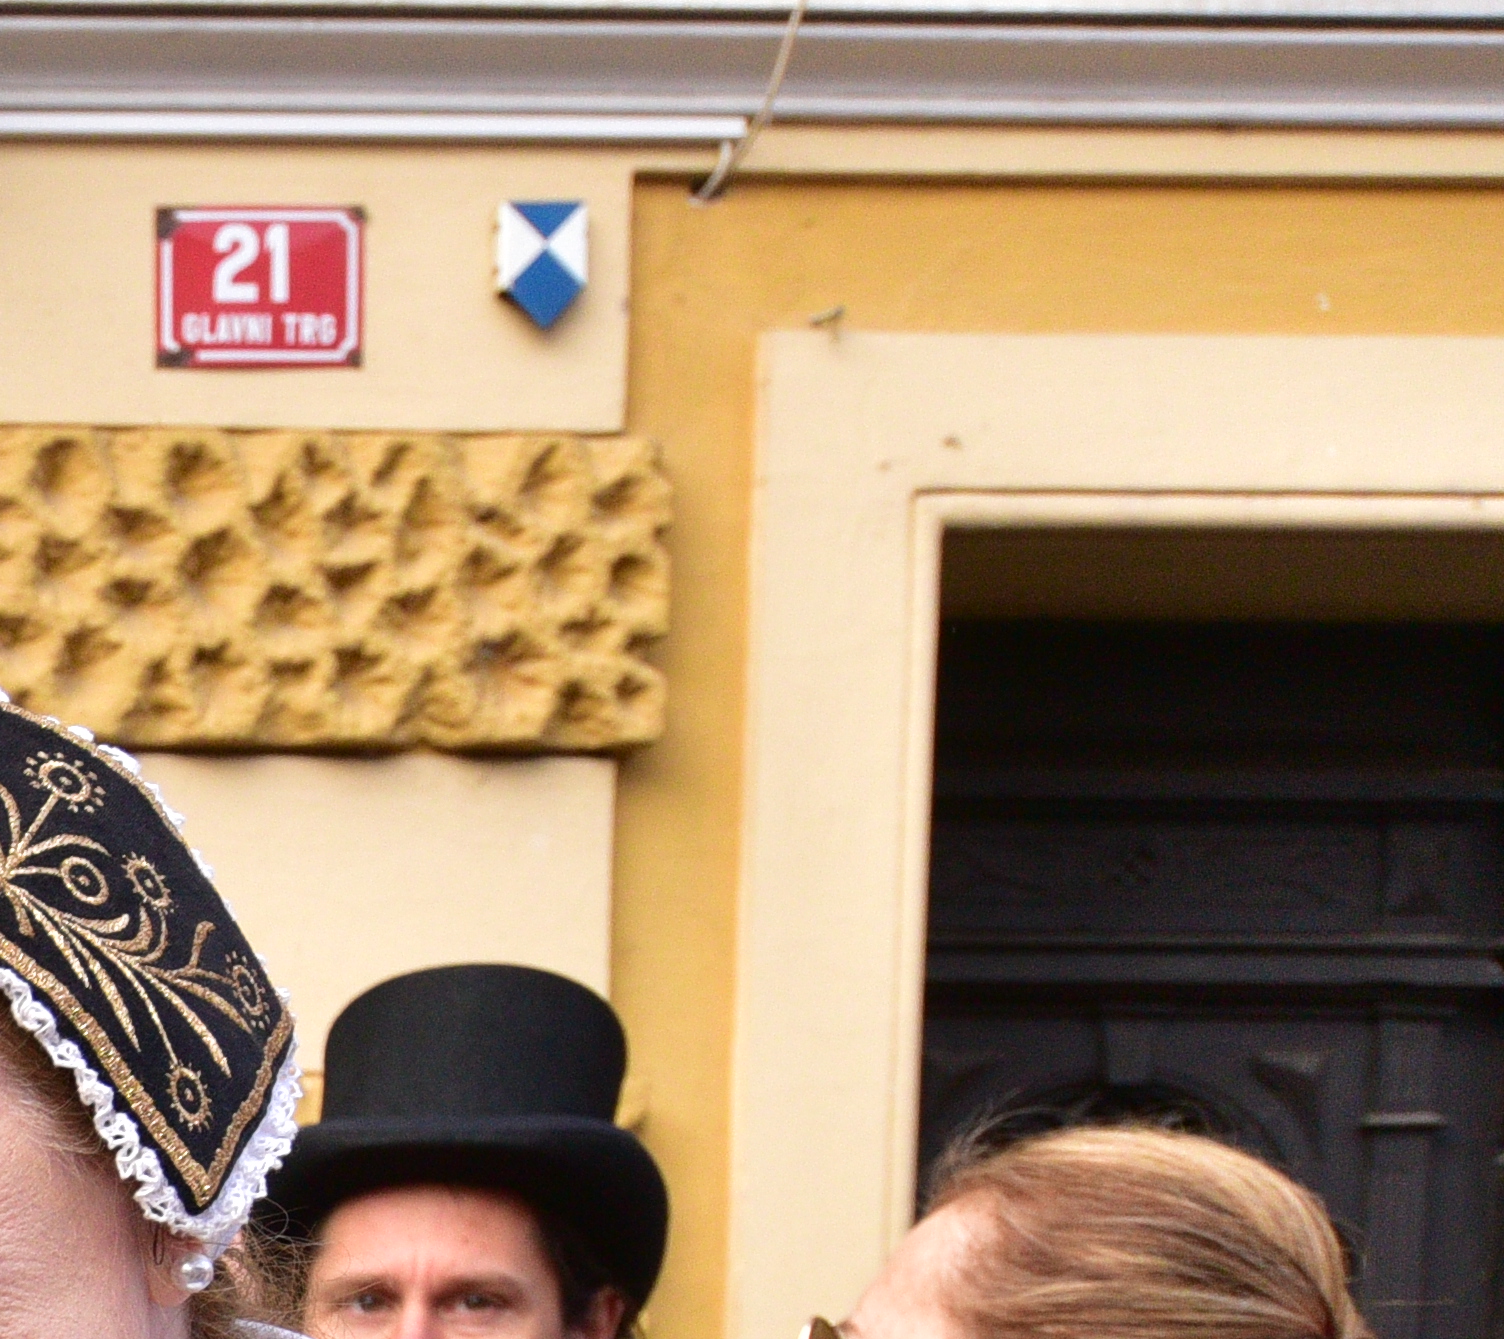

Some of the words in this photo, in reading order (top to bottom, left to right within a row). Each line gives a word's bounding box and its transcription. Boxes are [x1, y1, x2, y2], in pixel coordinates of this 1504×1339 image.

[213, 224, 289, 303] 21
[182, 311, 273, 346] GLAVNI
[282, 311, 338, 347] TRG
